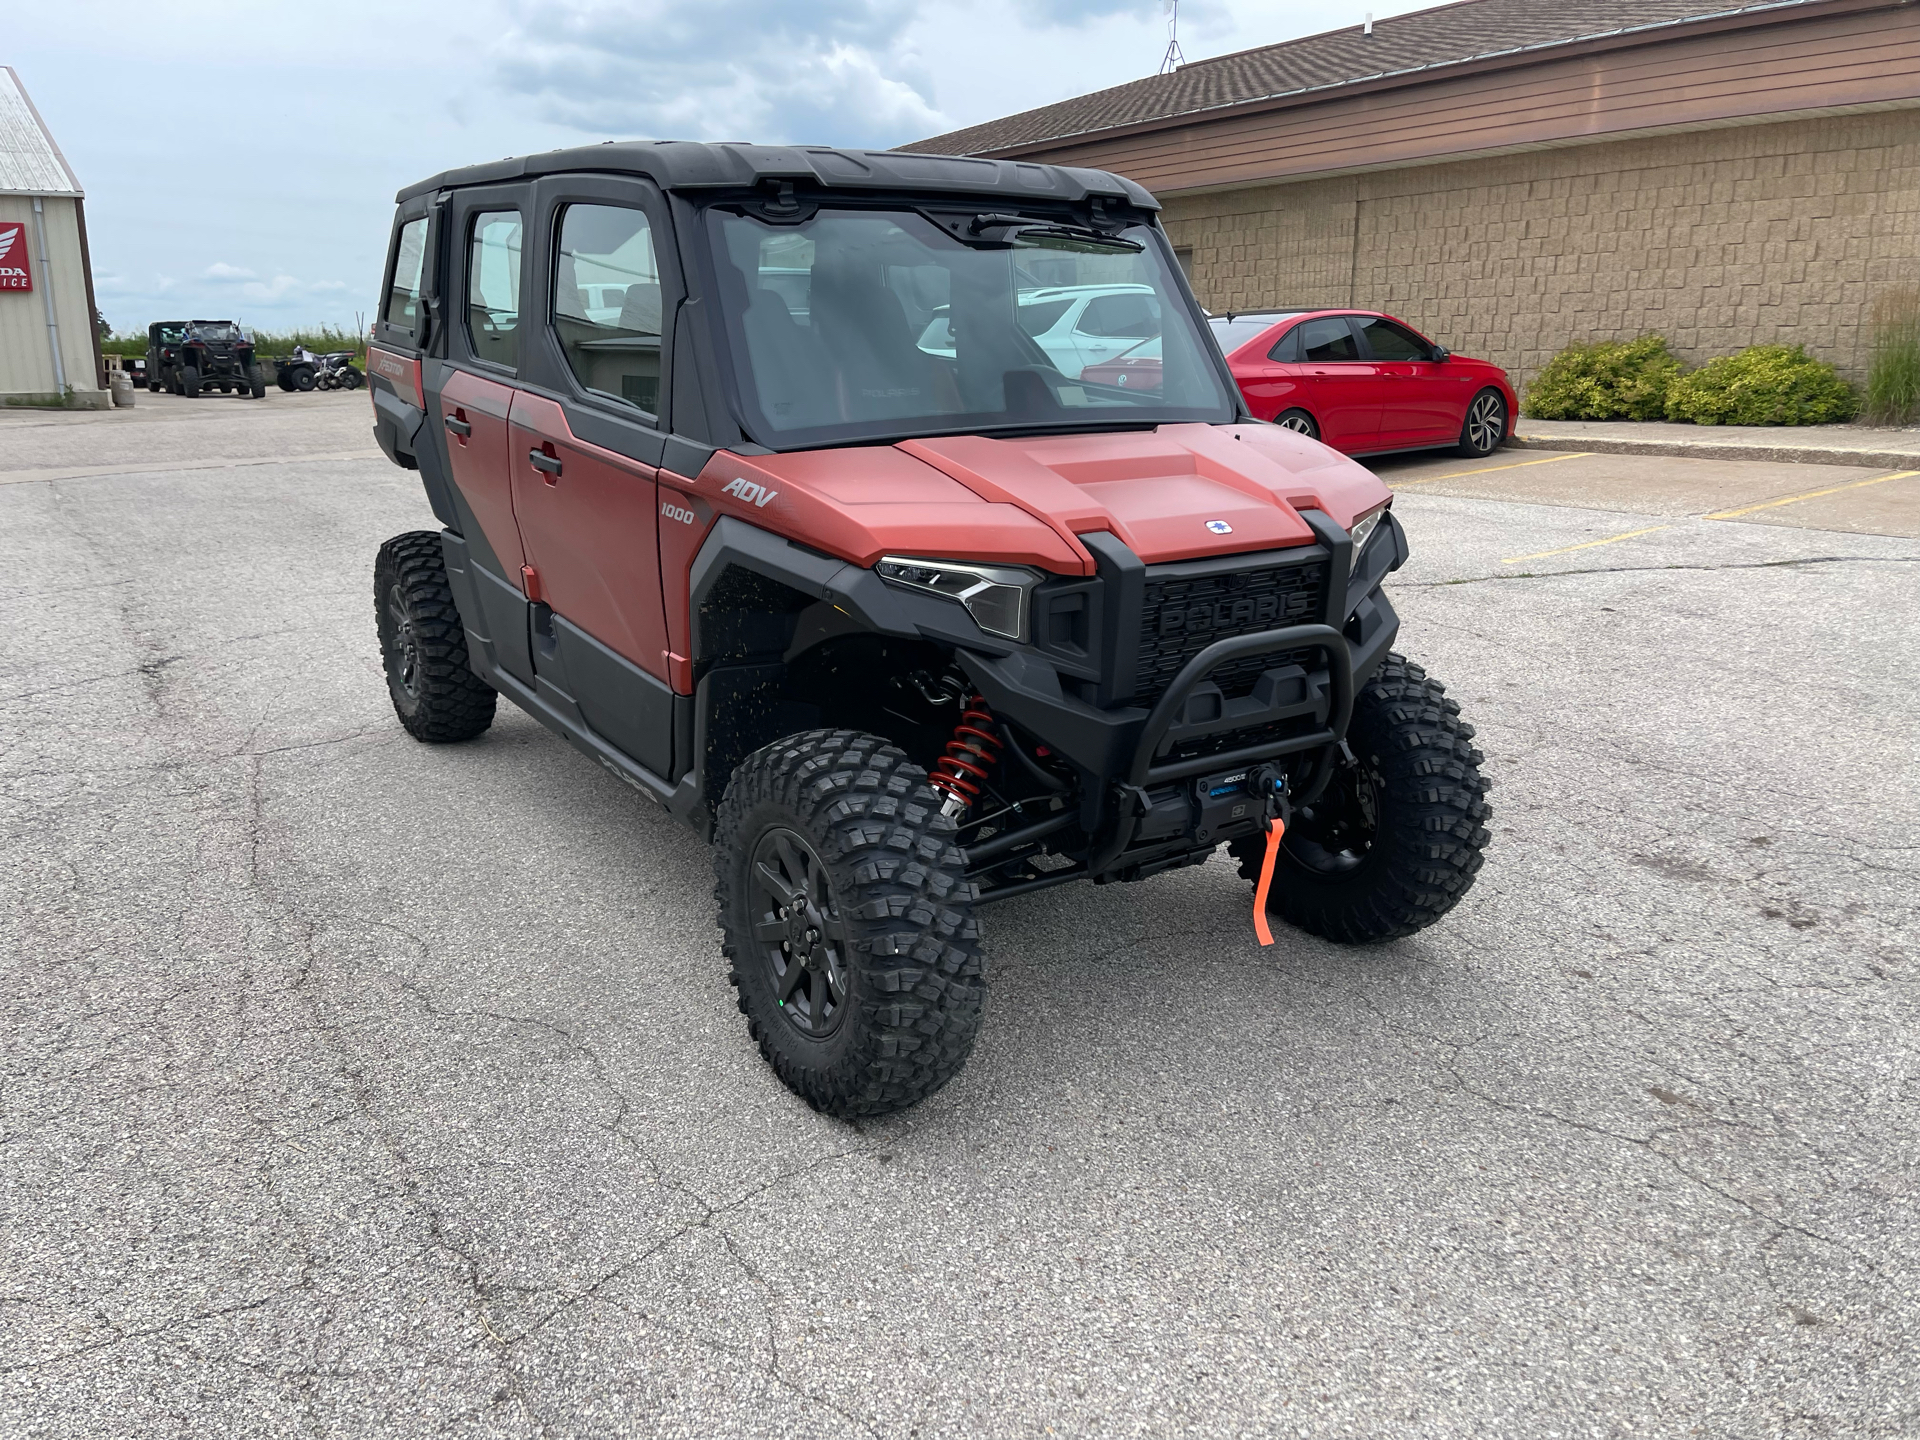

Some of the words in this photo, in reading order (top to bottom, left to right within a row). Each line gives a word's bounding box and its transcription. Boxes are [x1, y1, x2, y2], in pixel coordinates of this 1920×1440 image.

[721, 477, 778, 508] ADV
[661, 502, 695, 525] 1000
[1159, 592, 1308, 636] POLARIS
